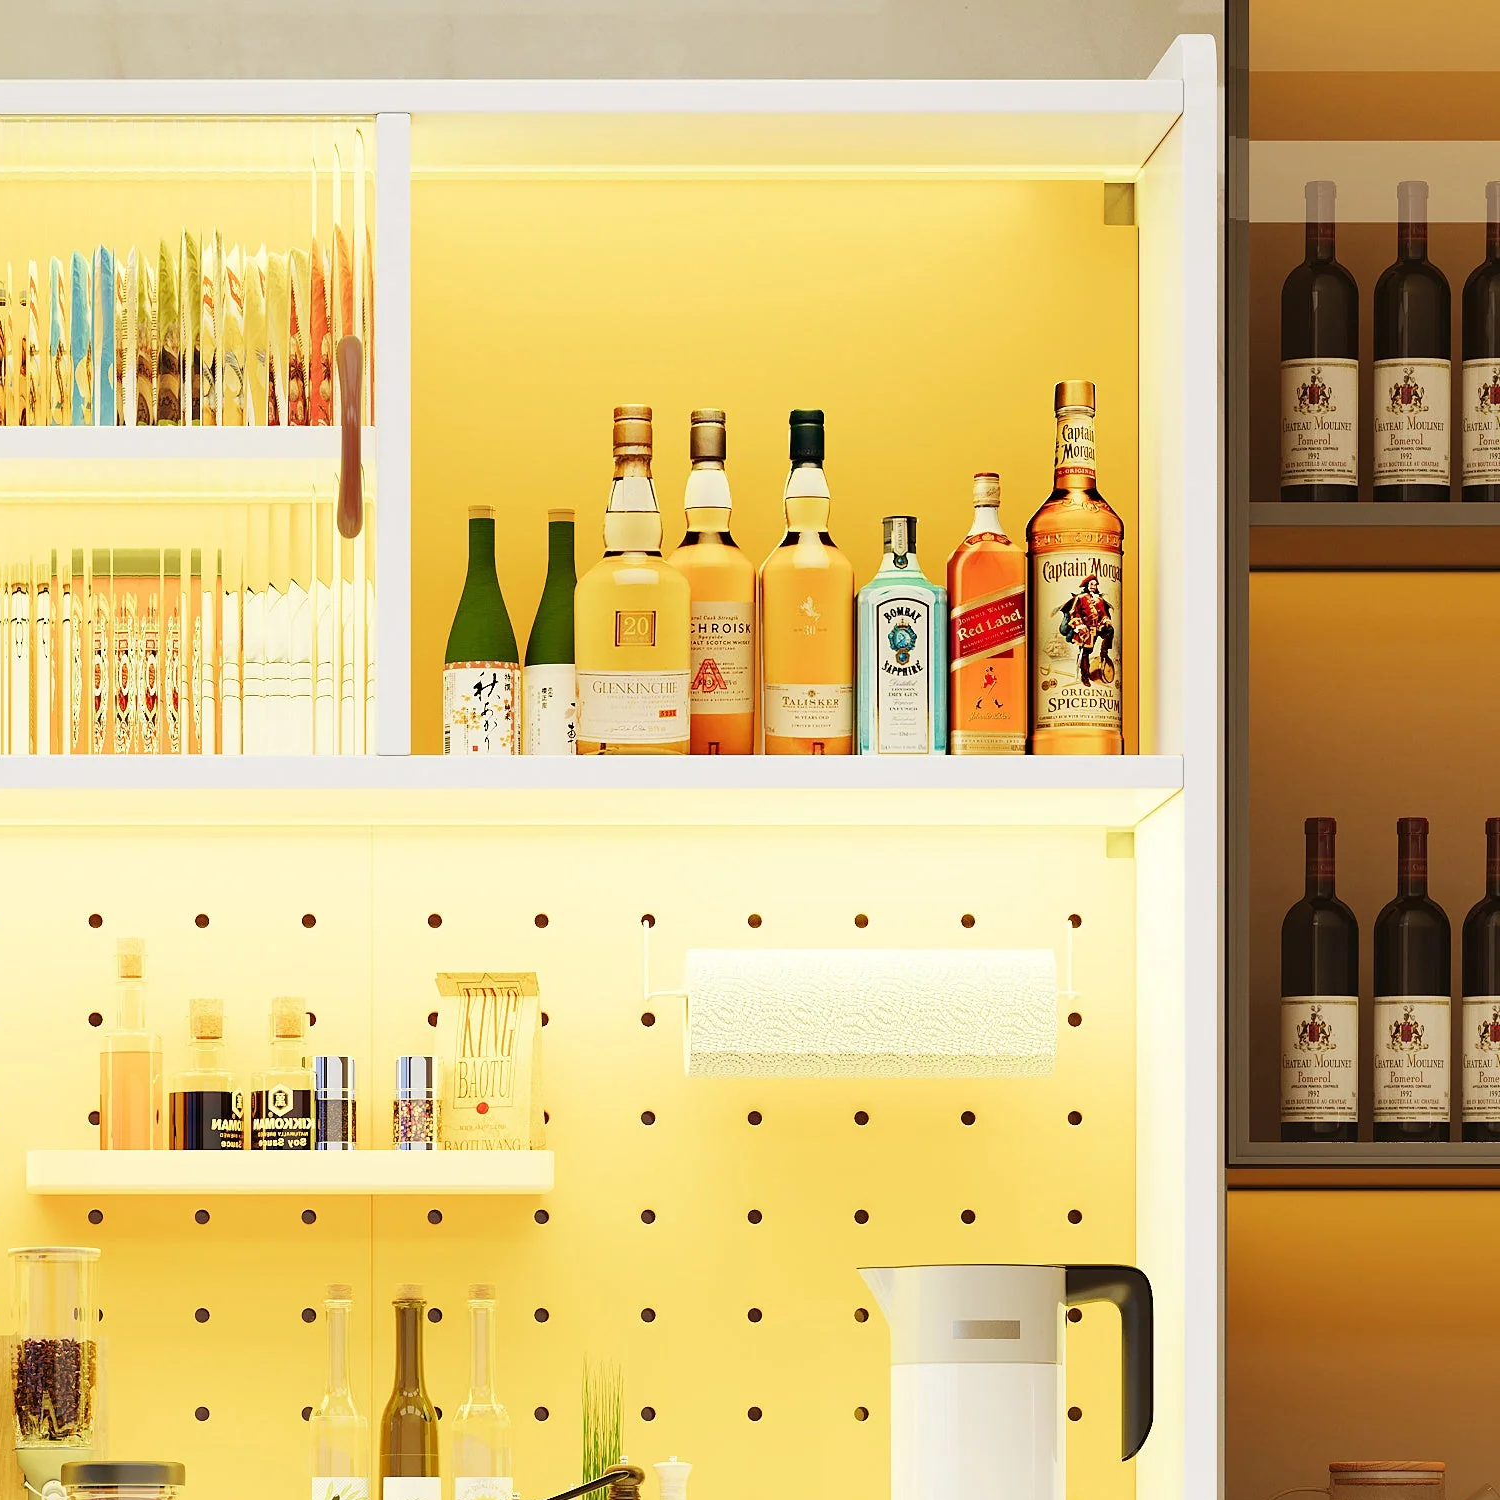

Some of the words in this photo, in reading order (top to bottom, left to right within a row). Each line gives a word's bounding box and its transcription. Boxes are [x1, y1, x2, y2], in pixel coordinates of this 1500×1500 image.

[1283, 418, 1311, 432] CHATEAU
[1315, 416, 1351, 431] MOULINET
[1375, 418, 1403, 432] CHATEAU
[1407, 416, 1444, 431] MOULINET
[1463, 418, 1492, 432] CHATEAU
[1298, 433, 1331, 445] Pomerol
[1390, 433, 1423, 445] Pomerol
[1479, 433, 1500, 445] Pome
[1065, 468, 1095, 476] ORIGINAL
[1043, 559, 1087, 583] Captain
[883, 607, 922, 624] BOMBAY
[624, 617, 649, 636] 20
[804, 625, 816, 635] 30
[956, 623, 984, 641] Red
[985, 609, 1021, 630] Label
[881, 660, 924, 676] SAPPHIRE
[593, 681, 677, 694] GLENKINCHIE
[1061, 689, 1114, 697] ORIGINAL
[782, 696, 839, 706] TALISKER
[1048, 698, 1097, 713] SPICED
[1099, 698, 1120, 713] RUM
[462, 987, 519, 1057] KING
[1283, 1054, 1311, 1068] CHATEAU
[1315, 1054, 1351, 1068] MOULINET
[1375, 1054, 1403, 1068] CHATEAU
[1407, 1054, 1444, 1068] MOULINET
[1463, 1054, 1492, 1068] CHATEAU
[1298, 1071, 1331, 1082] Pomerol
[1390, 1071, 1423, 1082] Pomerol
[1479, 1071, 1500, 1082] Pome
